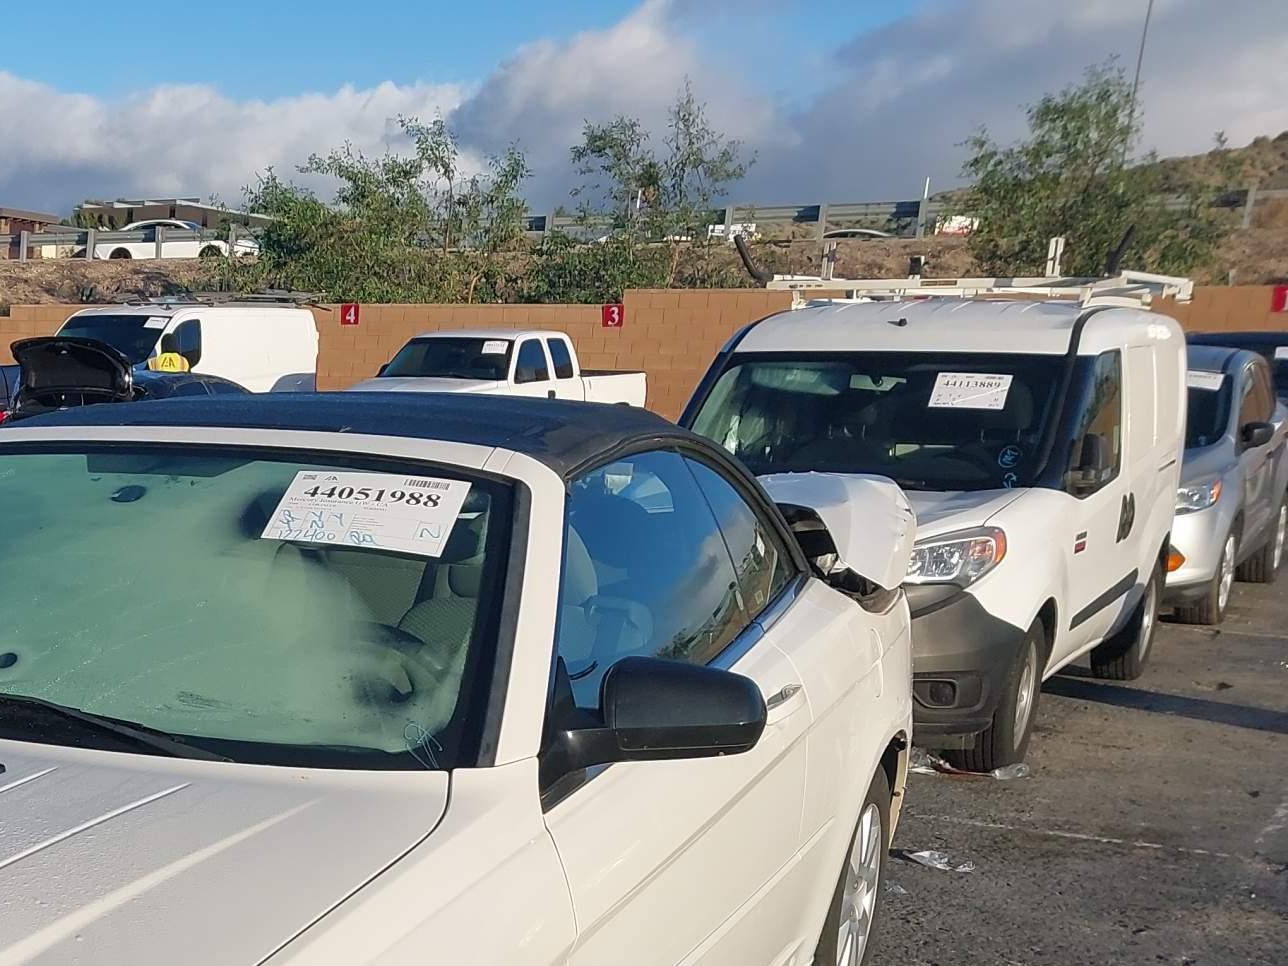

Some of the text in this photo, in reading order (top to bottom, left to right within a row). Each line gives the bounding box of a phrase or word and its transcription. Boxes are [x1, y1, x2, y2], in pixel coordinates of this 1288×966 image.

[346, 306, 355, 323] 4
[608, 306, 619, 325] 3
[943, 380, 1001, 388] 44113889
[304, 485, 441, 508] 44051988
